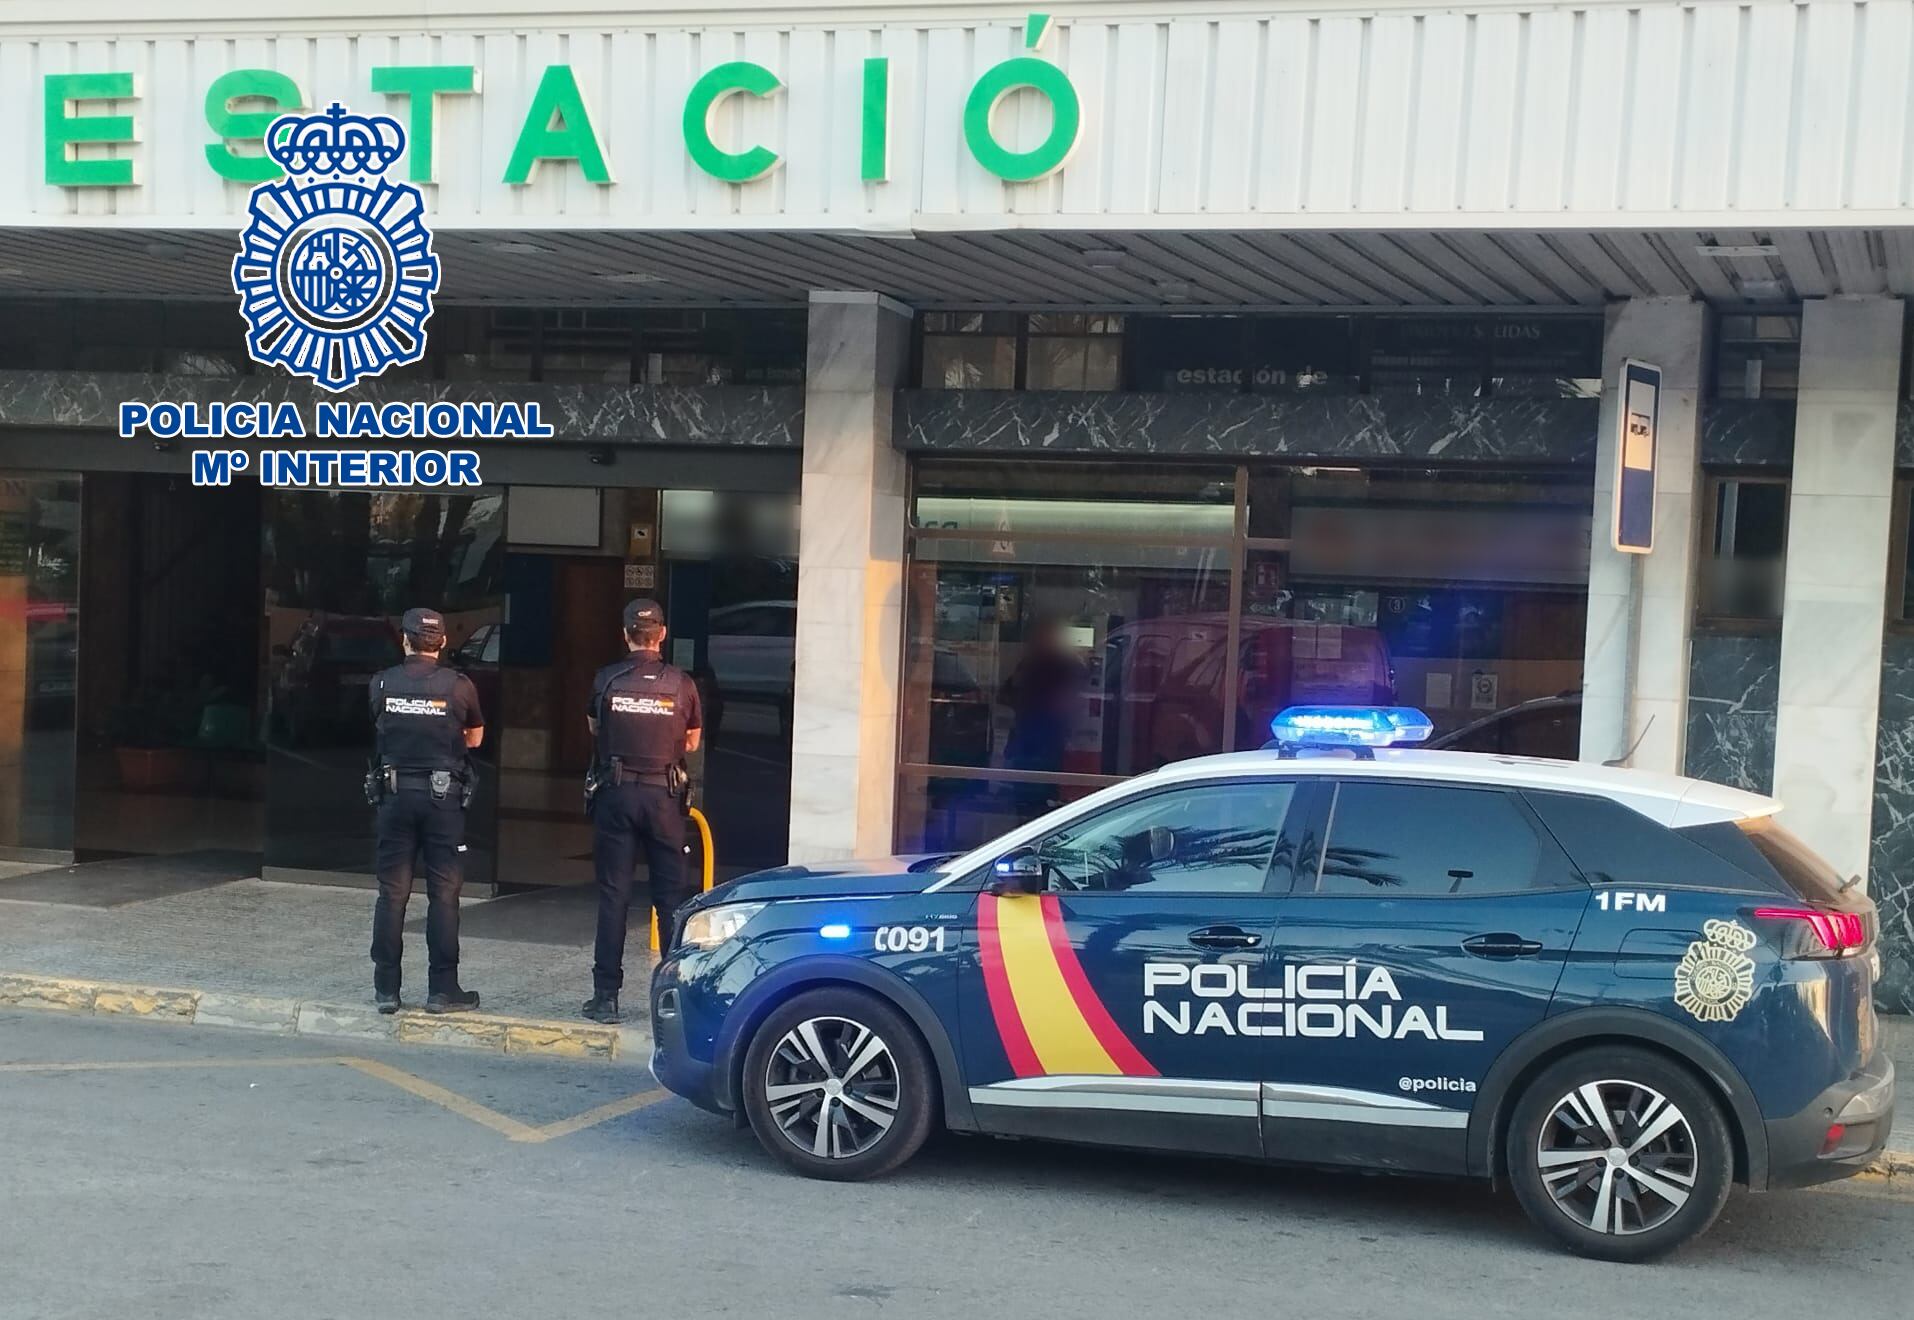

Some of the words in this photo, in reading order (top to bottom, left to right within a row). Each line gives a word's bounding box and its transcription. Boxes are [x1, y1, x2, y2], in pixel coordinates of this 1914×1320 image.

[45, 12, 1085, 186] ESTACIÓ
[1472, 323, 1541, 339] SLIDAS
[385, 705, 447, 716] NACIONAL
[611, 704, 674, 716] NACIONAL
[887, 926, 945, 952] 091
[1143, 957, 1402, 1000] POLICÍA
[1143, 1001, 1485, 1041] NACIONAL
[1398, 1075, 1478, 1094] @policia
